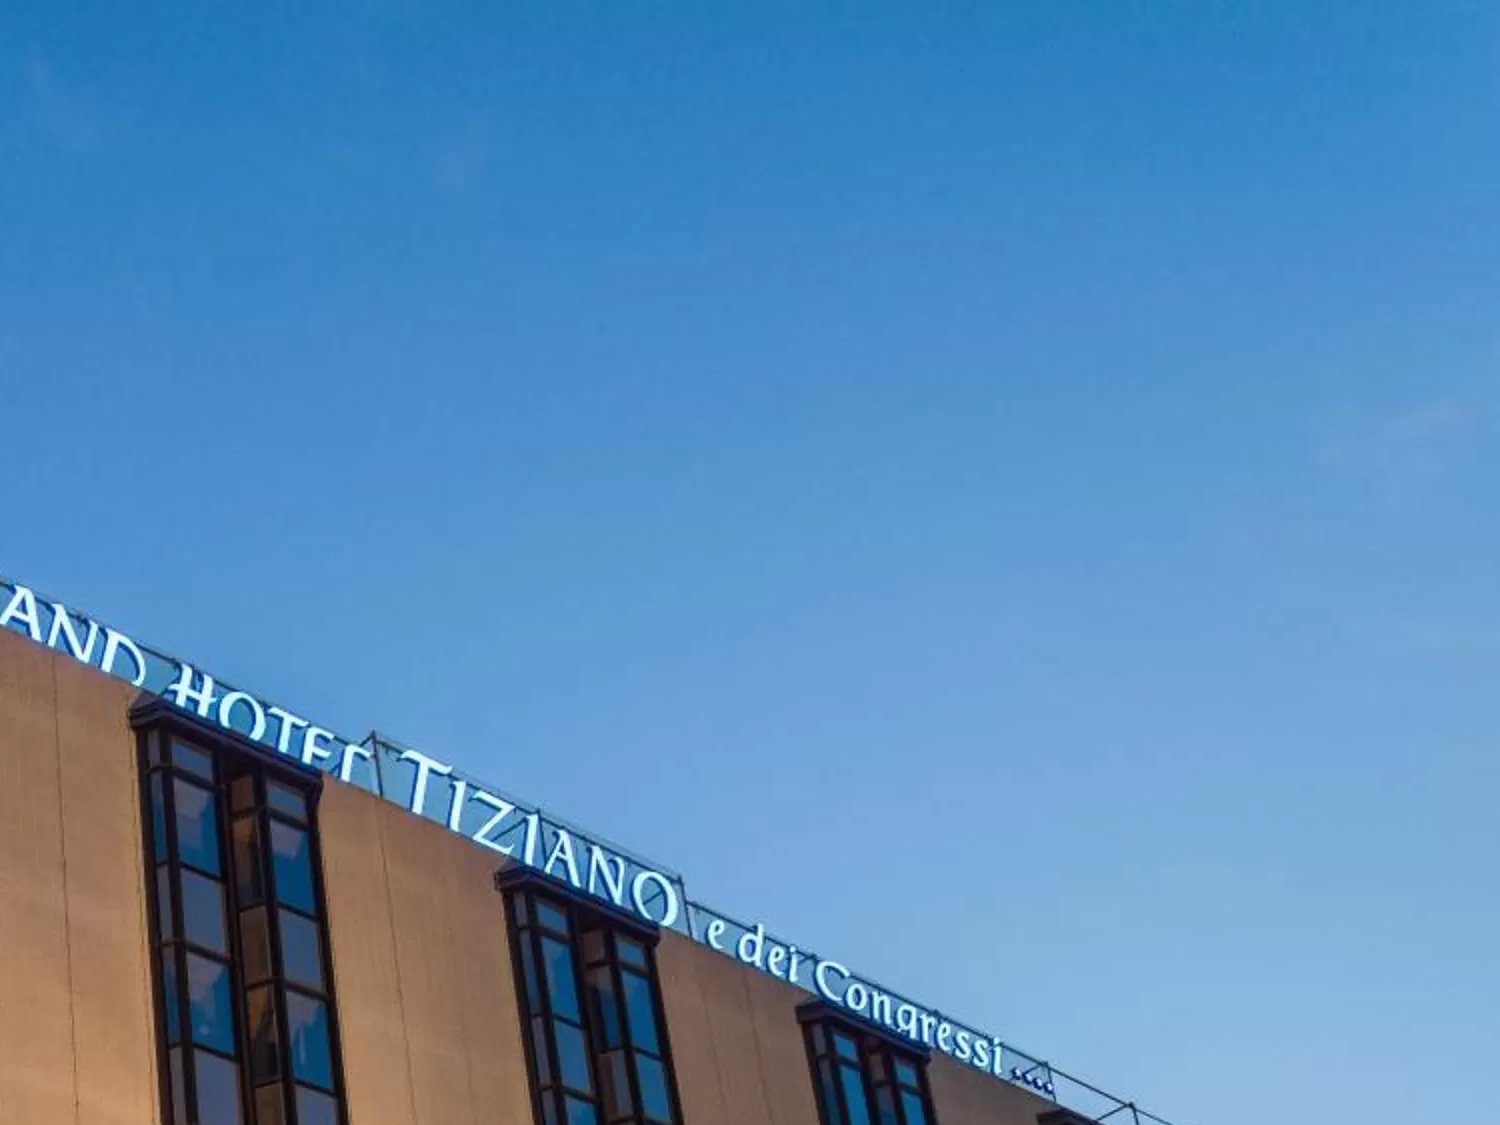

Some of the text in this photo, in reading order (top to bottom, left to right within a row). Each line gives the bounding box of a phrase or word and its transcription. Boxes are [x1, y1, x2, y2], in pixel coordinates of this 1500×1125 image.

[399, 749, 679, 928] TIZIANO
[706, 919, 725, 950] e
[738, 923, 799, 983] dei
[815, 960, 1003, 1076] Congressi
